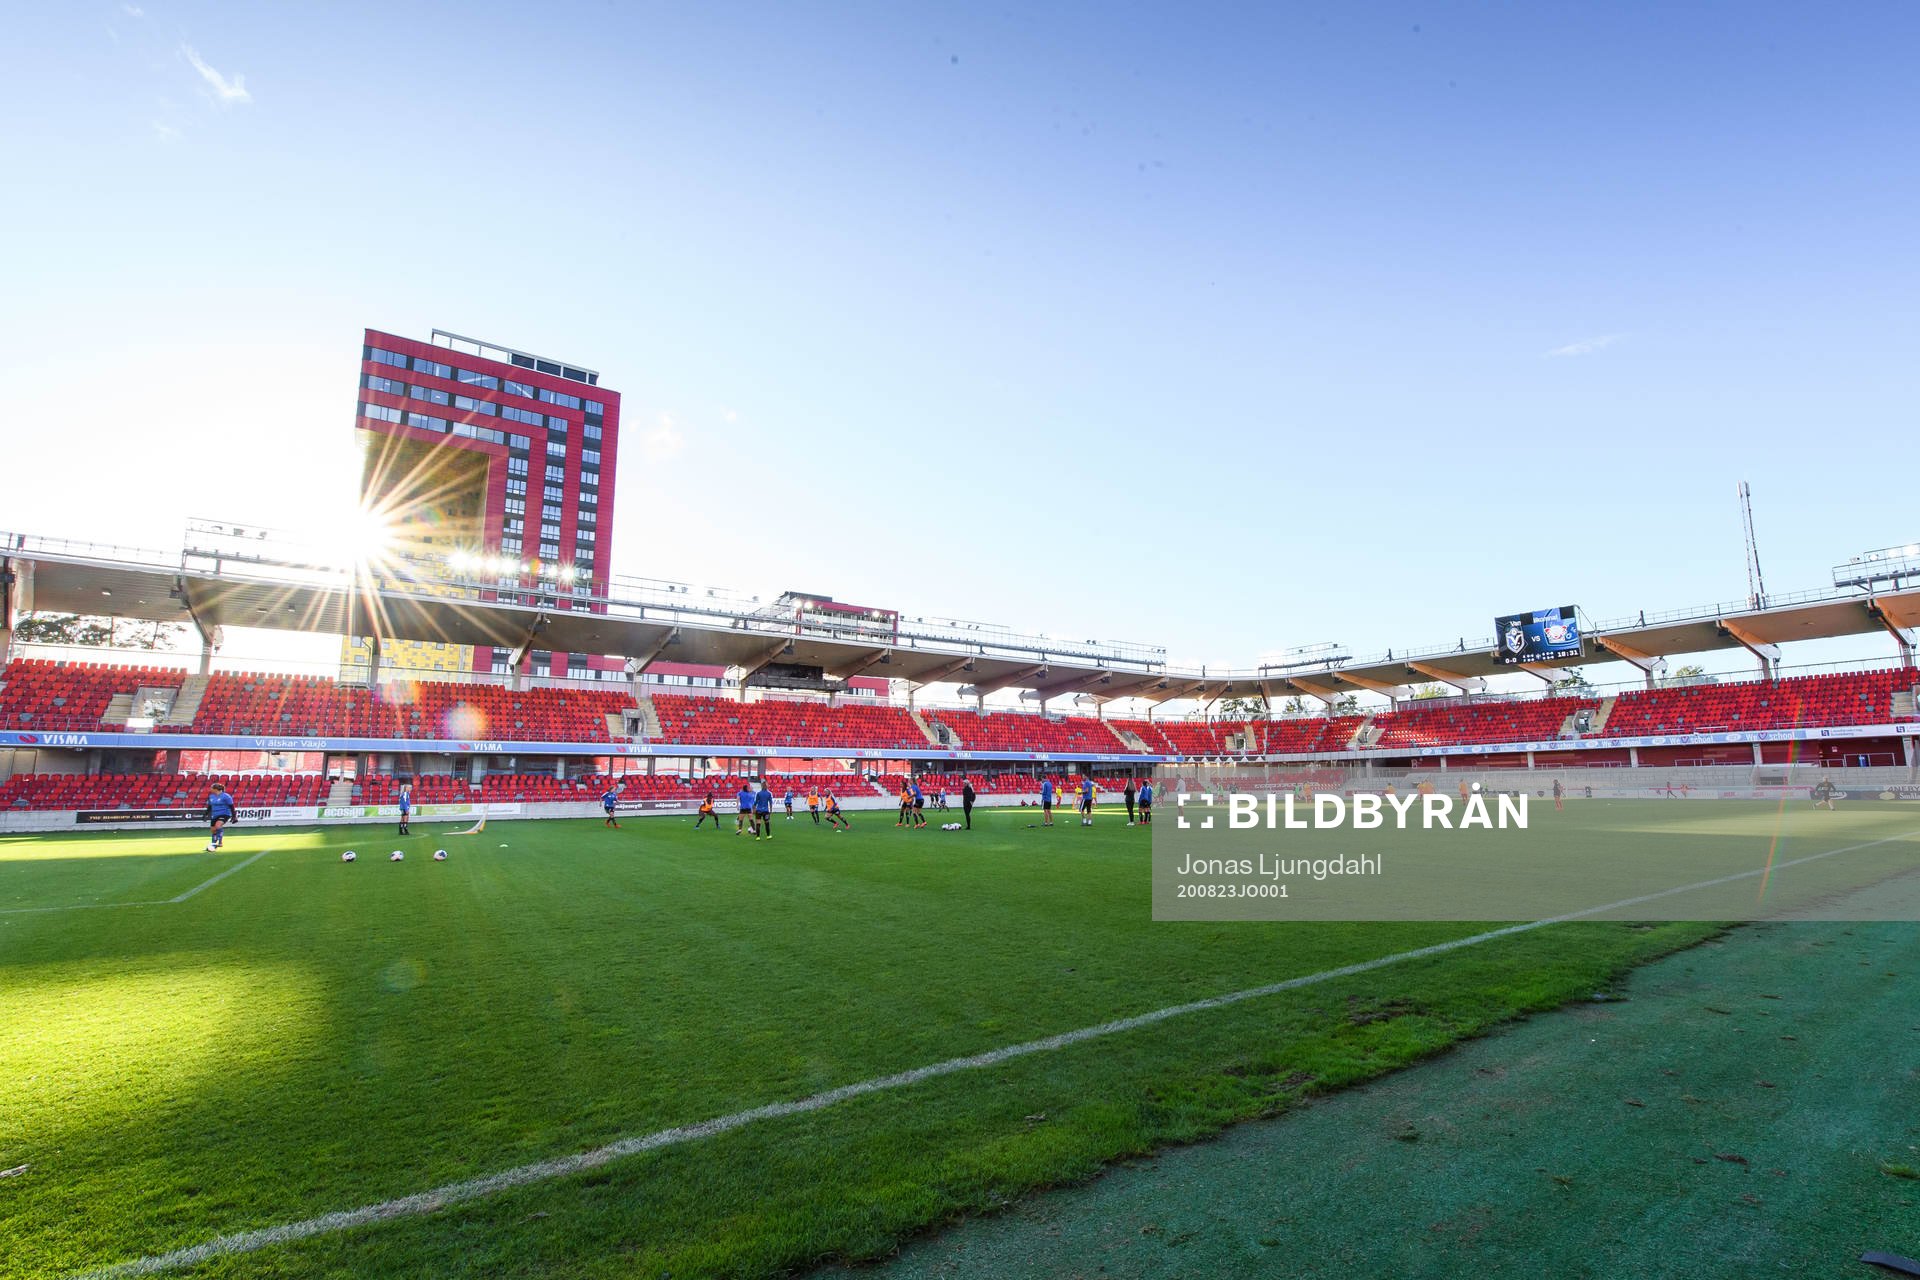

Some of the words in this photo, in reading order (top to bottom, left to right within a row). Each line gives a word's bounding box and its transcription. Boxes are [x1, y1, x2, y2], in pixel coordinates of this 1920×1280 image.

[43, 735, 88, 745] VISMA
[267, 739, 298, 747] älskar
[301, 740, 327, 749] Växjö
[473, 743, 503, 751] VISMA
[628, 745, 653, 753] VISMA
[235, 808, 271, 820] cosign
[324, 807, 365, 817] ecosign
